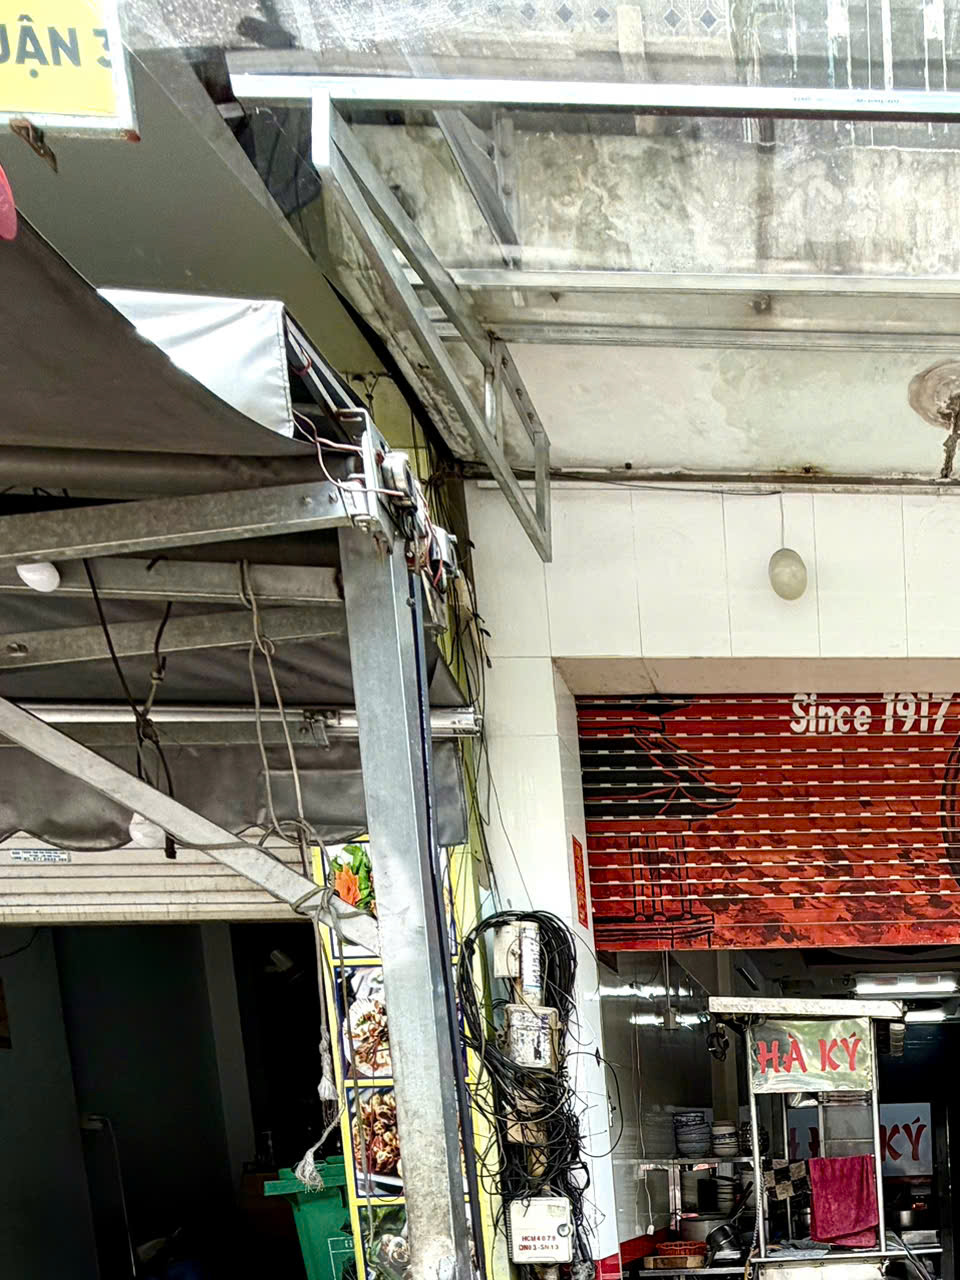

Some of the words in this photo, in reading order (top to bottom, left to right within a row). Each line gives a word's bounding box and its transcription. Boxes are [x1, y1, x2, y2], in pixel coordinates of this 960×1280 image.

[789, 692, 872, 733] Since
[882, 692, 953, 732] 1917
[757, 1031, 808, 1074] HÀ
[818, 1031, 863, 1073] KÝ
[880, 1116, 927, 1162] KÝ
